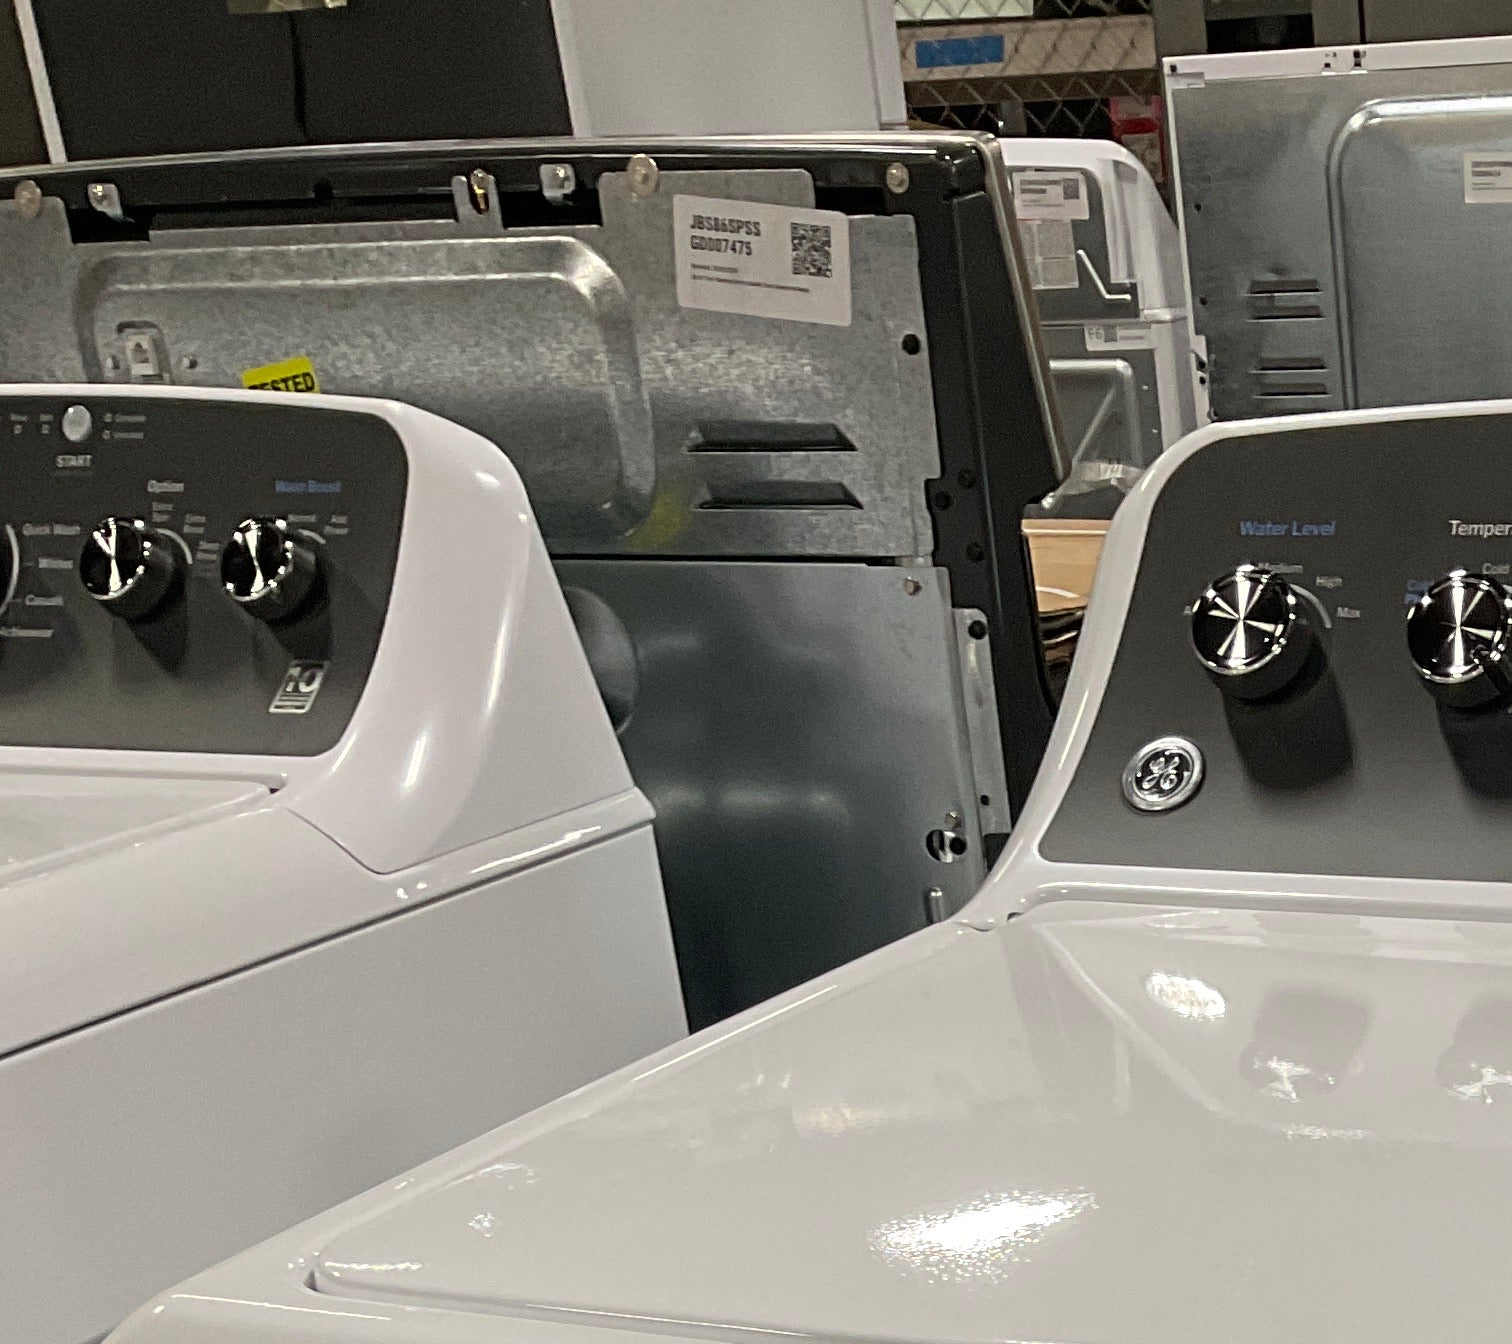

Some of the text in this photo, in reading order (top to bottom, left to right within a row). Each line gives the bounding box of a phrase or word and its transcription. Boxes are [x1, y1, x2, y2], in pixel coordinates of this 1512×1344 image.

[247, 371, 315, 392] STED
[1239, 520, 1337, 536] Water Level
[1481, 562, 1510, 575] Cold
